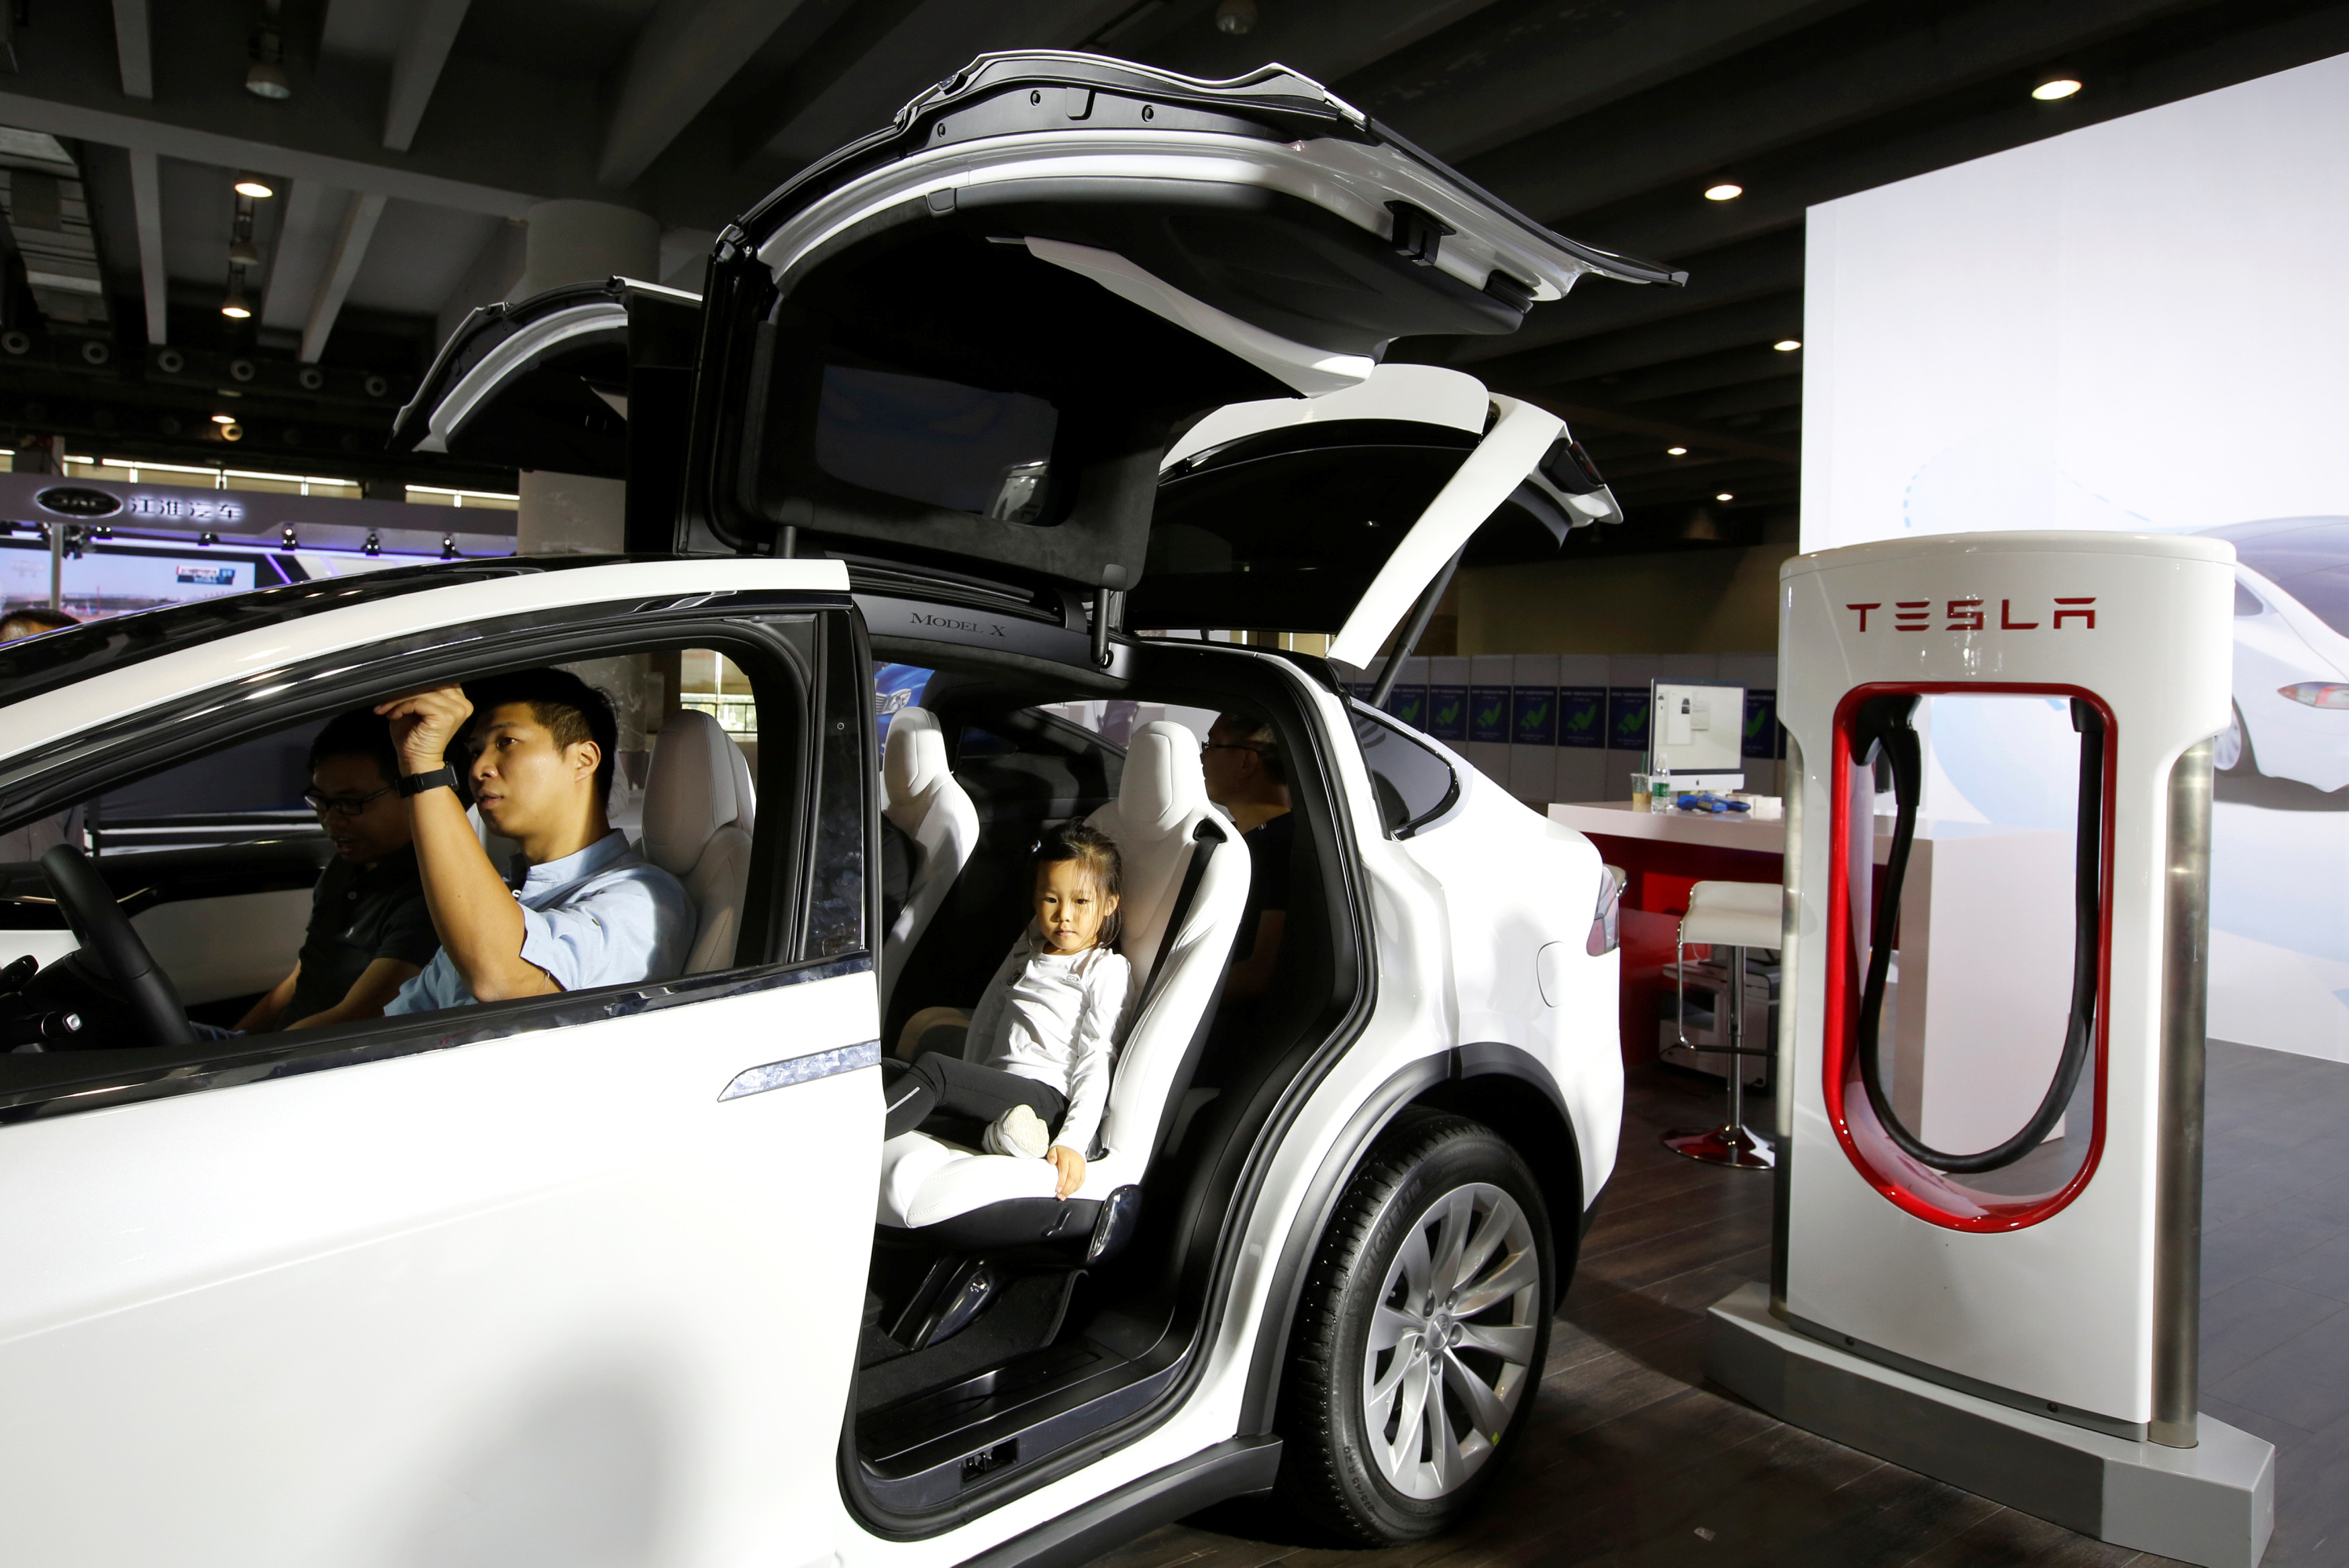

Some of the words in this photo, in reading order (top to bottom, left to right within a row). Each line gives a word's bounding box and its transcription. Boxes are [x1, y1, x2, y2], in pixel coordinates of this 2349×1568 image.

[130, 496, 243, 519] 江淮汽车
[1846, 596, 2097, 632] TESLA
[990, 624, 1006, 637] X
[1360, 1177, 1422, 1282] MICHELIN
[1343, 1445, 1352, 1463] 20
